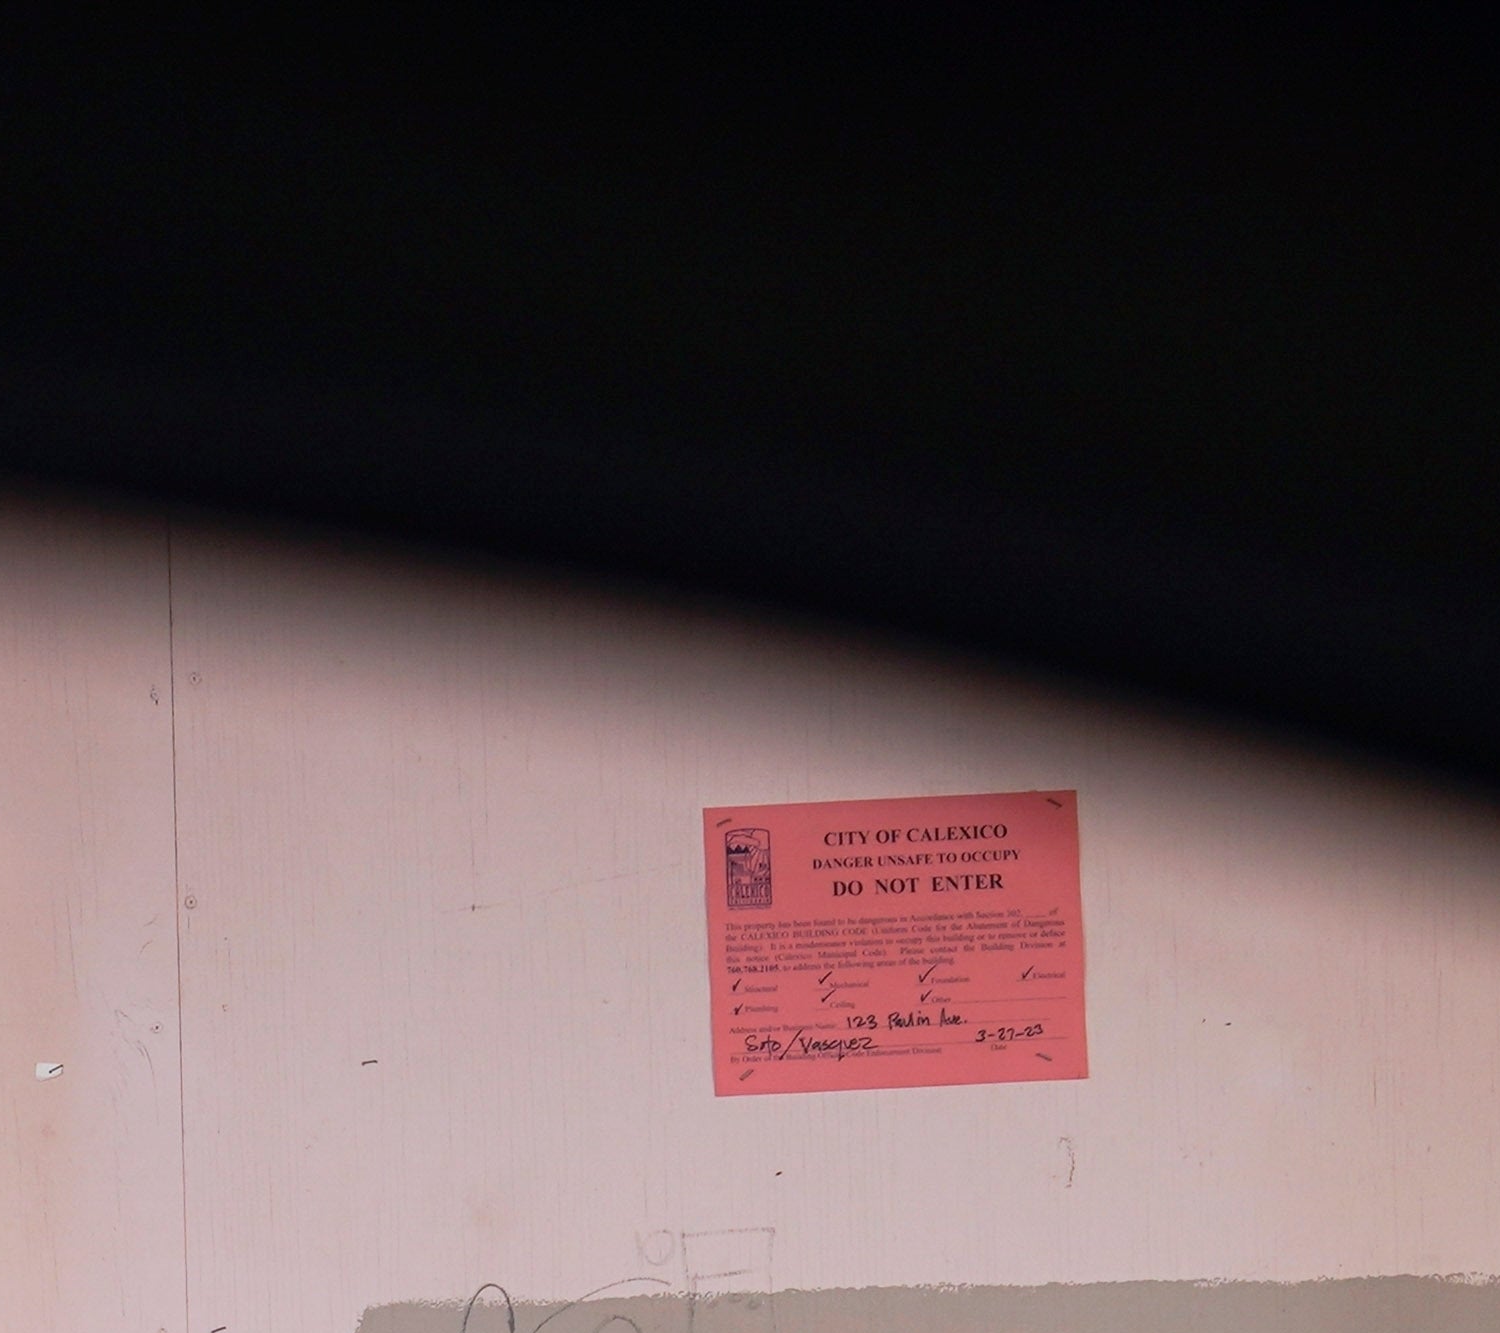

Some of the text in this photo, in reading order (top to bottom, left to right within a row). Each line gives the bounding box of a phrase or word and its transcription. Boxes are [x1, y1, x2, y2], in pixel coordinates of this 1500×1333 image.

[824, 823, 1008, 847] CITY OF CALEXICO
[813, 849, 1021, 870] DANGER UNSAFE TO OCCUPY
[833, 874, 1004, 897] DO NOT ENTER
[741, 932, 790, 941] CALEXICO
[793, 930, 839, 939] BUILDING
[842, 929, 866, 937] CODE
[932, 995, 952, 1004] Other
[847, 1014, 879, 1031] 123
[974, 1023, 1044, 1043] 3-27-23
